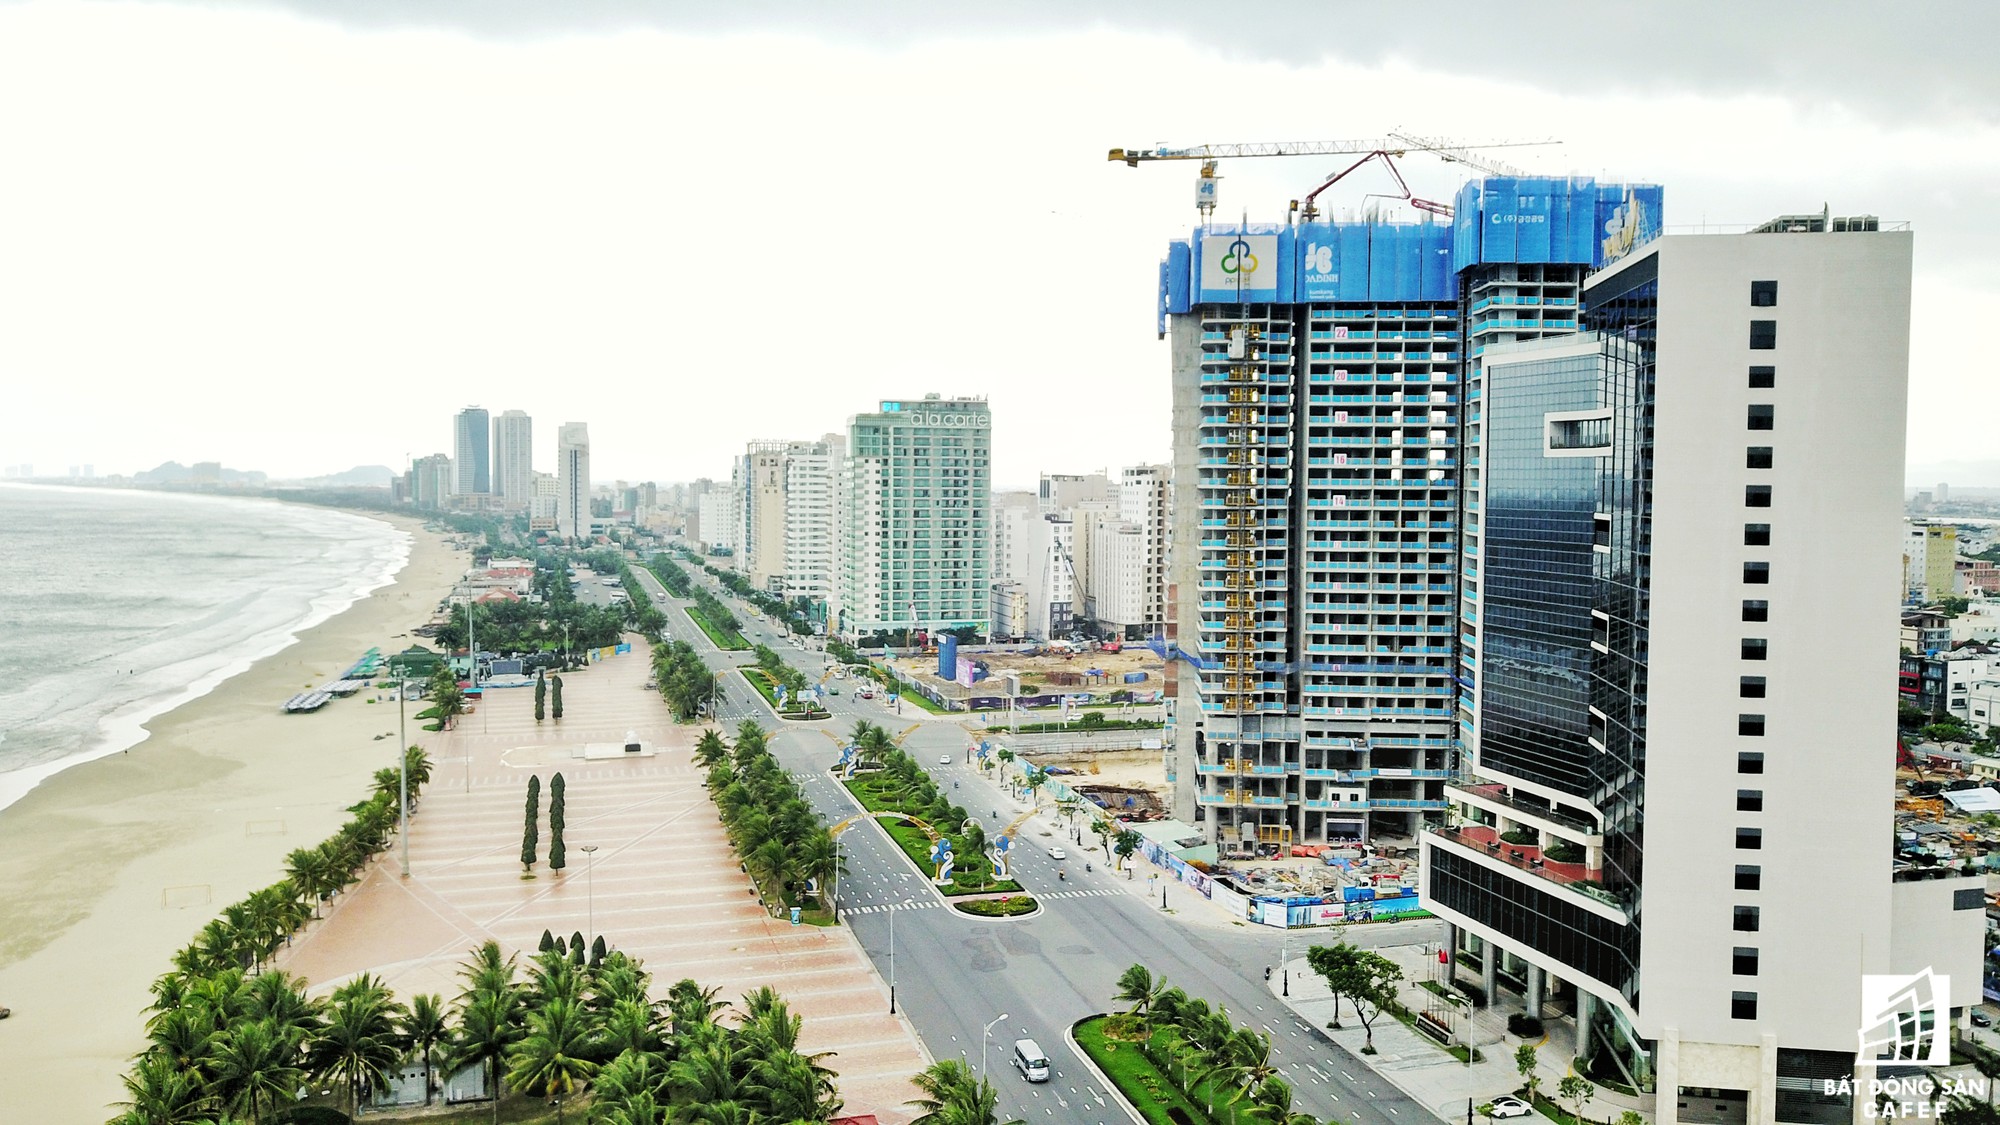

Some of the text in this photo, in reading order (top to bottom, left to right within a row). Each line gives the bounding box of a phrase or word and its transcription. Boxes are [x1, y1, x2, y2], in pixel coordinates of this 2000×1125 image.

[1336, 328, 1346, 338] 22
[1336, 371, 1346, 380] 20
[911, 410, 988, 426] à la carte
[1337, 413, 1346, 421] 18
